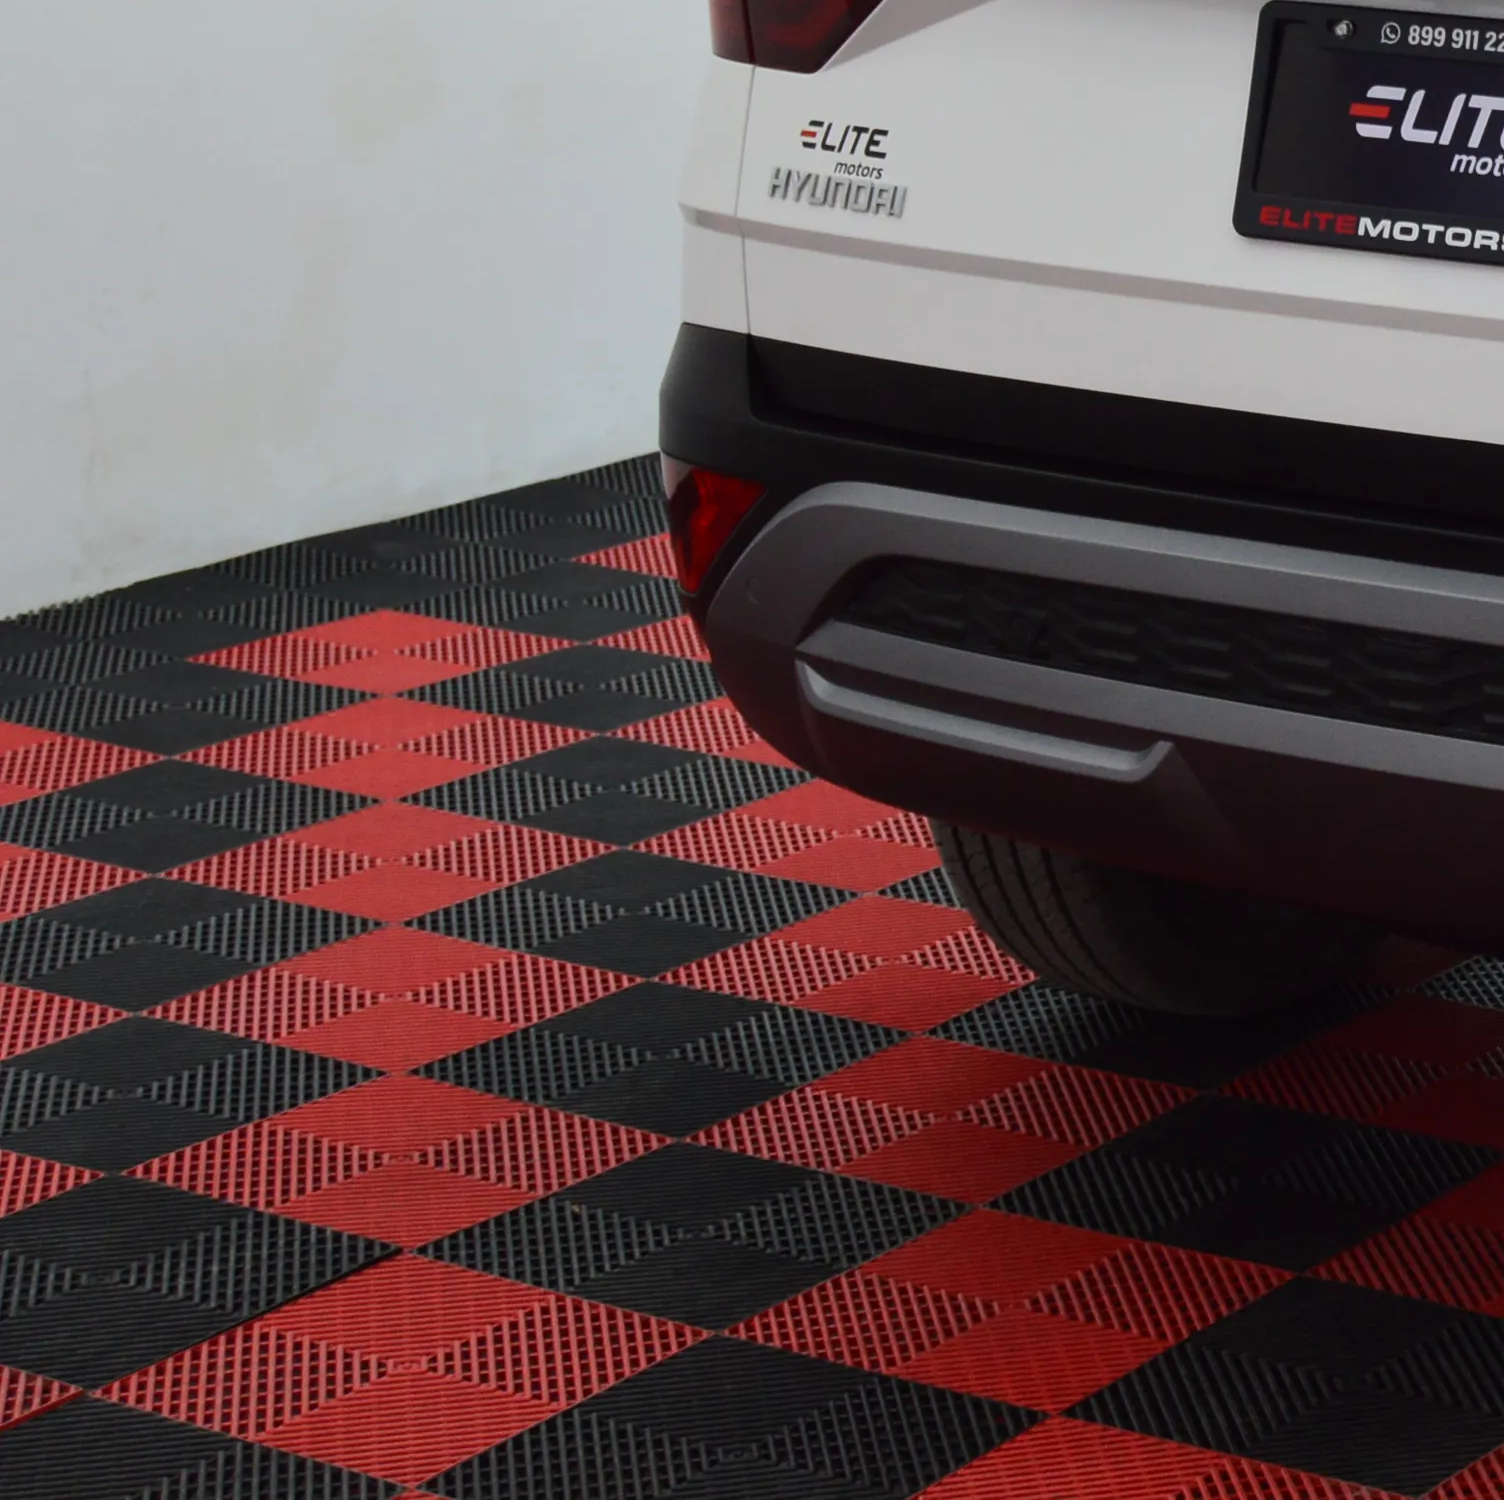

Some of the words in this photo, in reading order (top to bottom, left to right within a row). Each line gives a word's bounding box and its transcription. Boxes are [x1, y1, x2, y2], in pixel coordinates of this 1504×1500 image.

[1408, 25, 1447, 47] 899
[1451, 28, 1480, 50] 911
[800, 120, 889, 159] ELITE
[833, 161, 883, 179] motors
[768, 166, 908, 219] HYUNDAI
